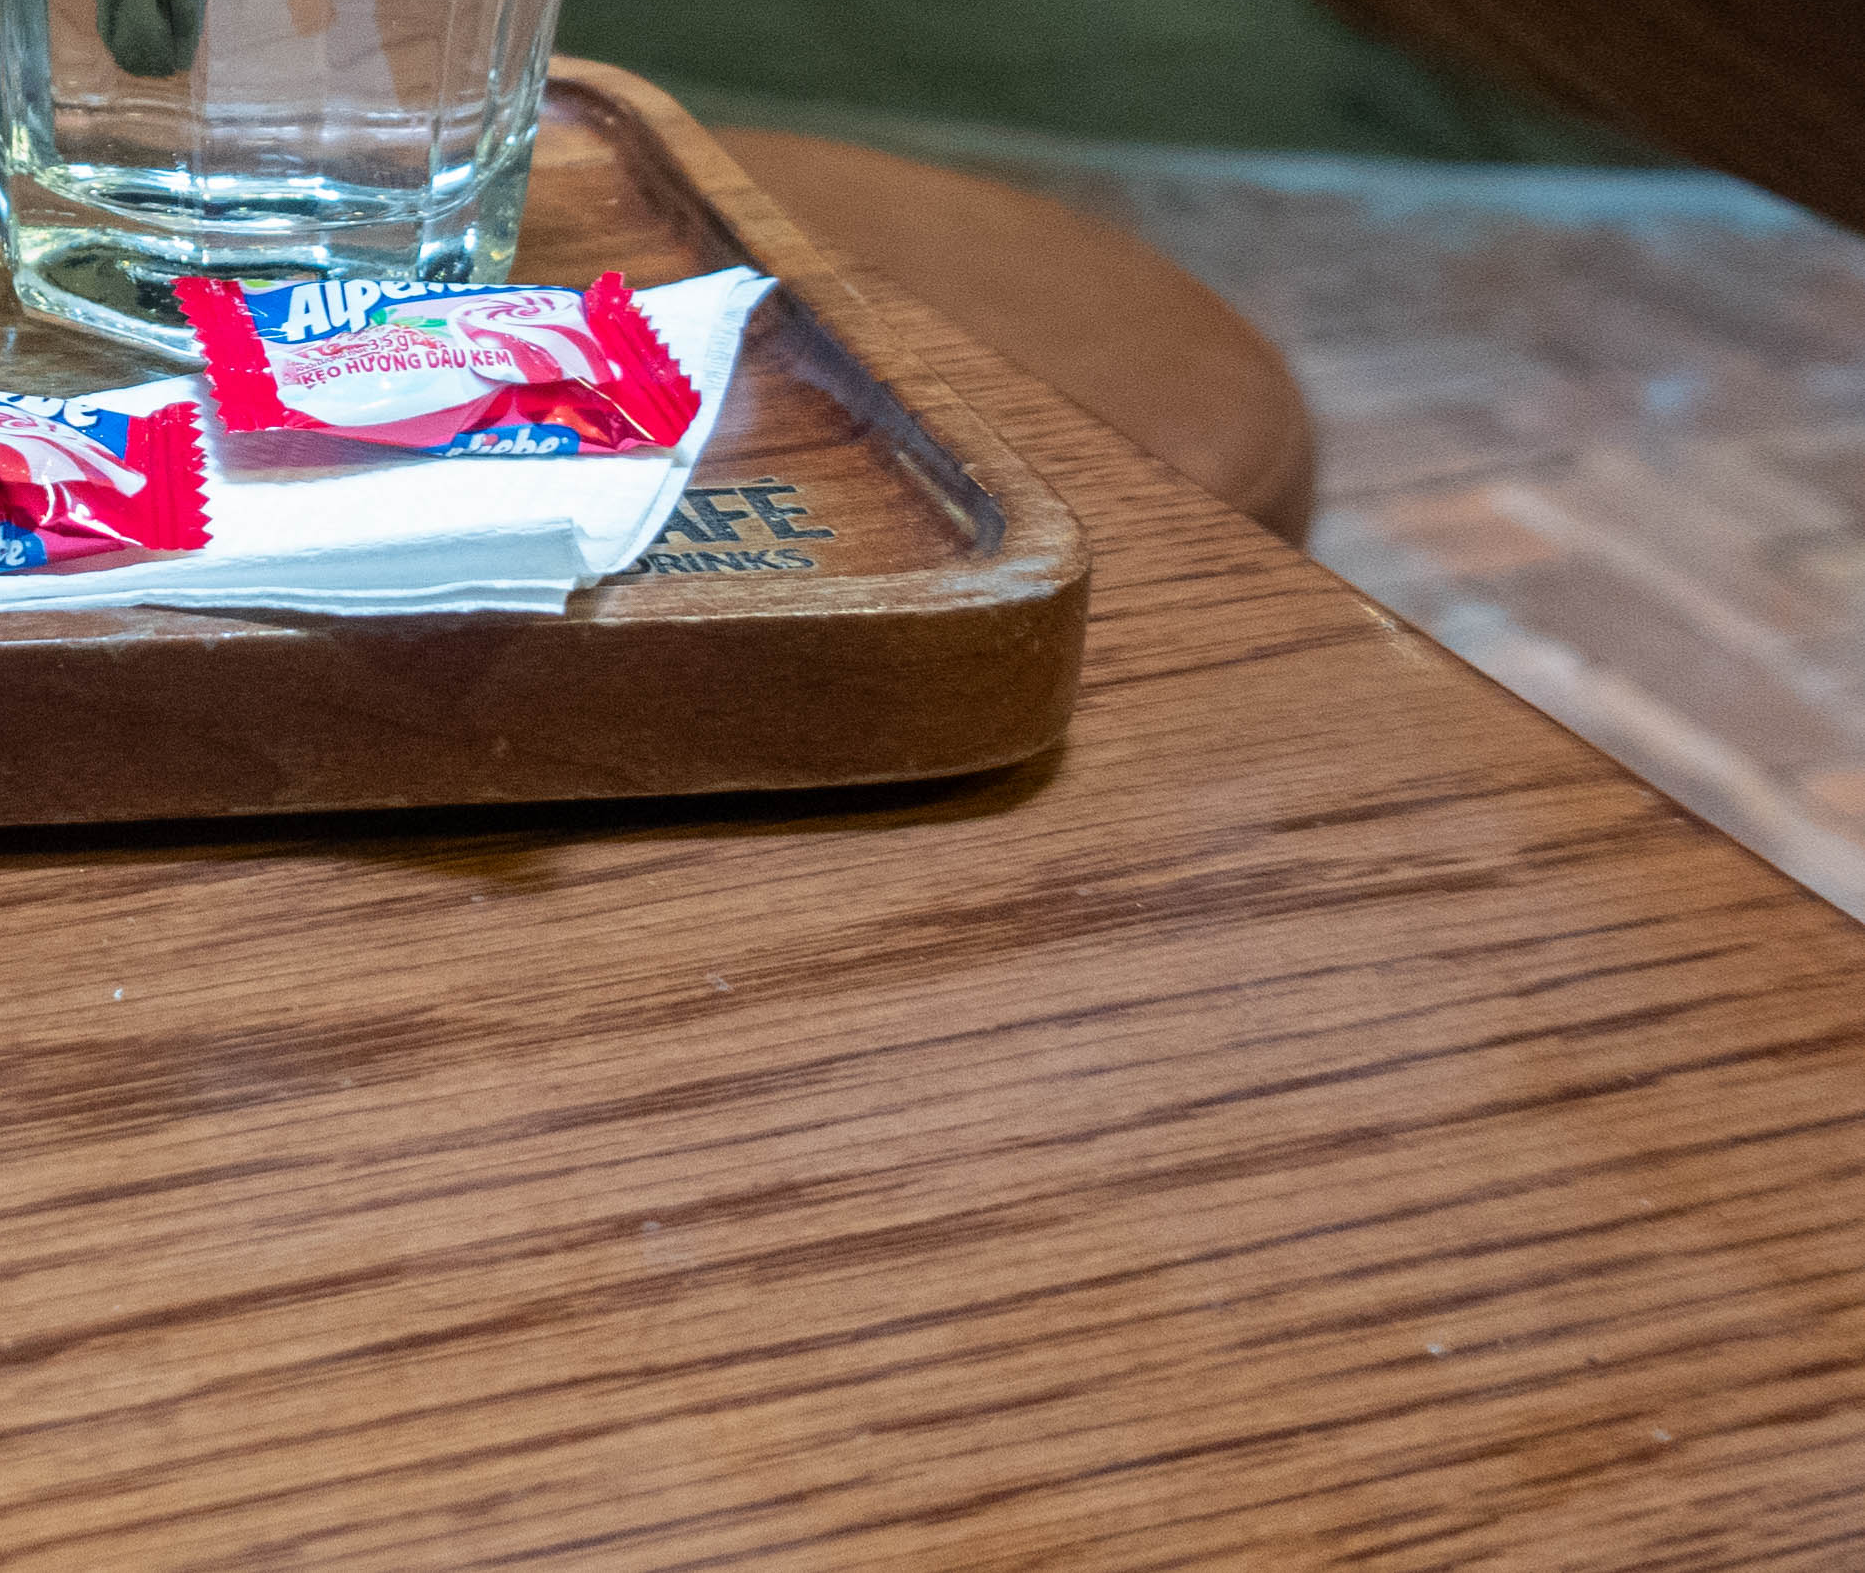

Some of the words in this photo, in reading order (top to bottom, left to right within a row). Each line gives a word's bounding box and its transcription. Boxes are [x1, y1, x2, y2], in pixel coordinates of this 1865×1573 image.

[346, 351, 421, 374] HƯƠNG
[472, 349, 512, 367] KEM
[652, 477, 835, 543] AFÉ
